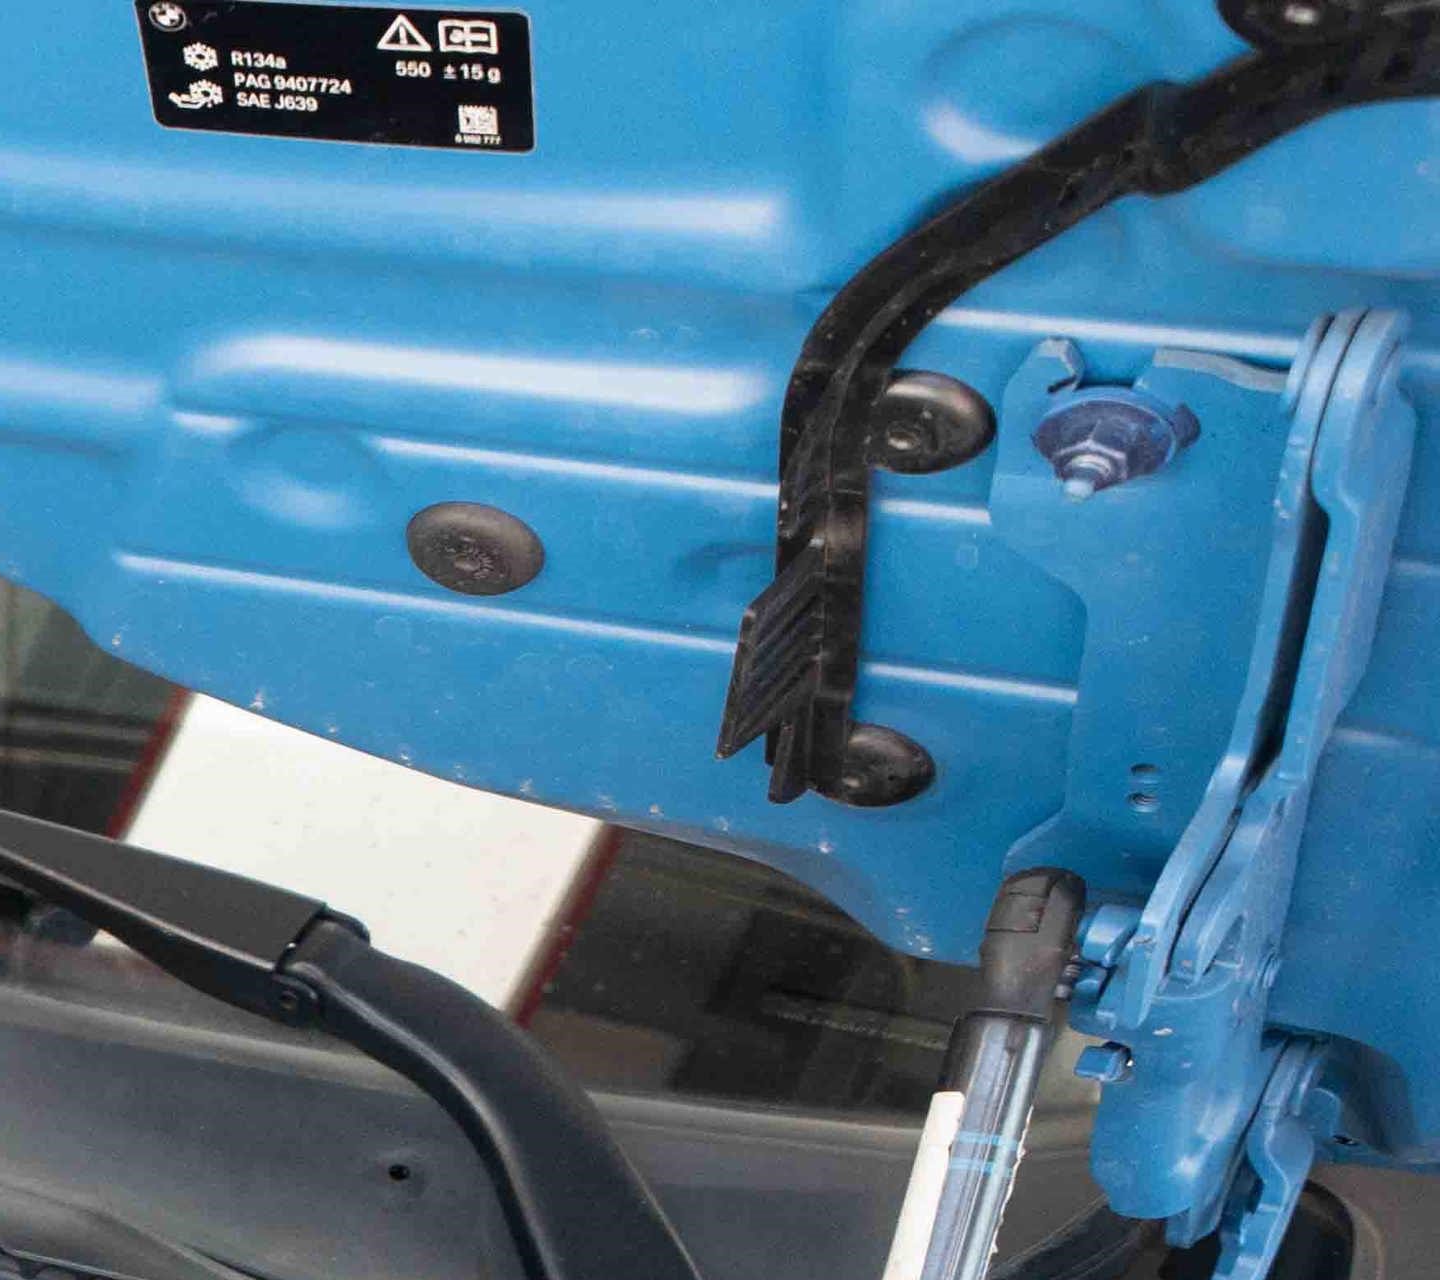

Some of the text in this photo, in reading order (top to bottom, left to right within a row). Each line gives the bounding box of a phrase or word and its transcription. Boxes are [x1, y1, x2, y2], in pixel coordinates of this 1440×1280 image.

[231, 50, 287, 69] R134a
[395, 60, 432, 78] 550
[233, 72, 352, 95] PAG 9407724
[236, 92, 318, 112] SAE J639
